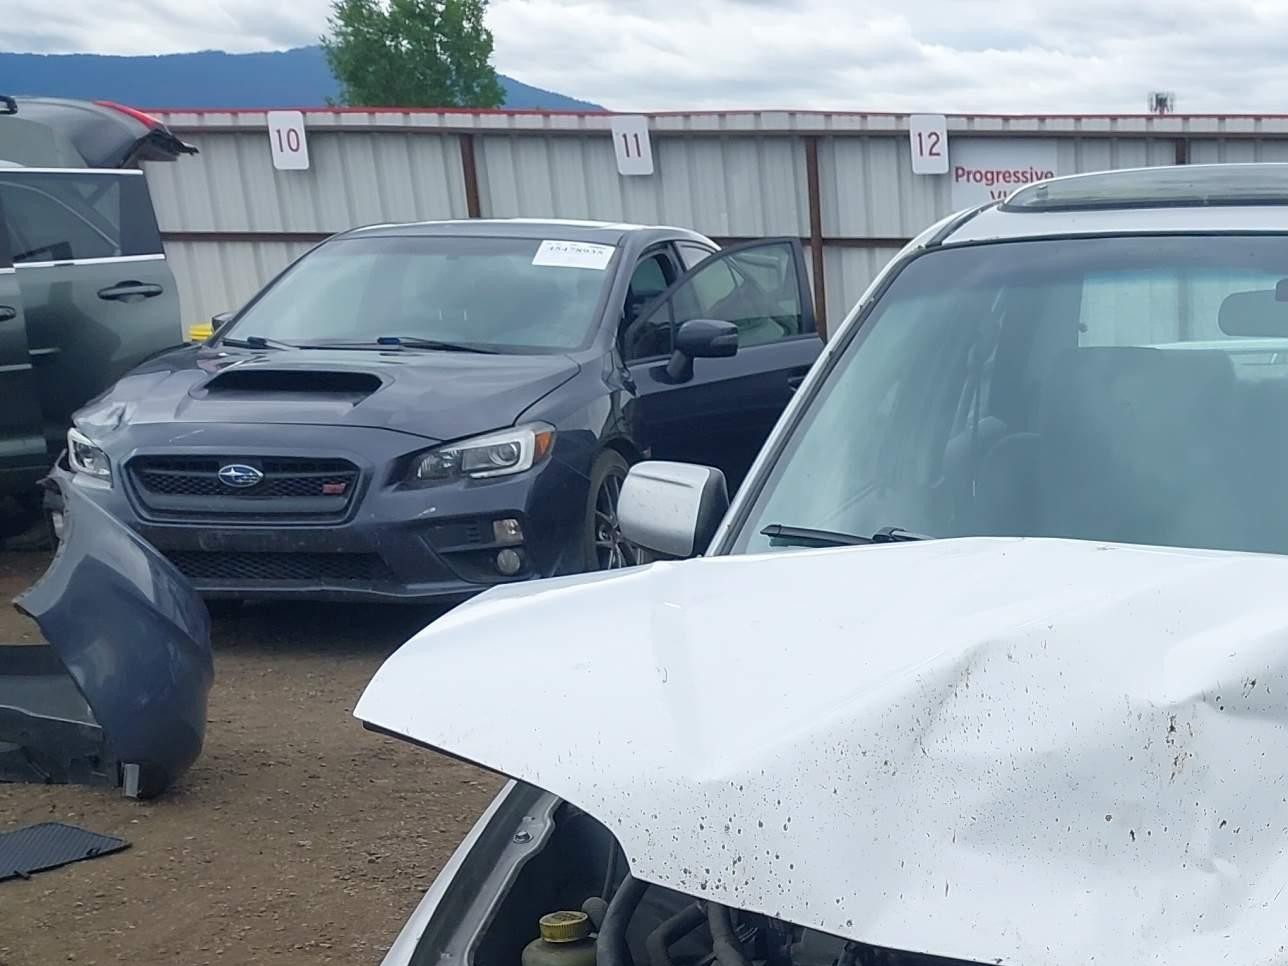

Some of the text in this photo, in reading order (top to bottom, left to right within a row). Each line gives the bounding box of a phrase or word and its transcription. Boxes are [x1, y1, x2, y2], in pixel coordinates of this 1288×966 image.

[276, 128, 300, 152] 10
[622, 132, 641, 158] 11
[917, 131, 941, 157] 12
[954, 166, 1055, 186] Progressive
